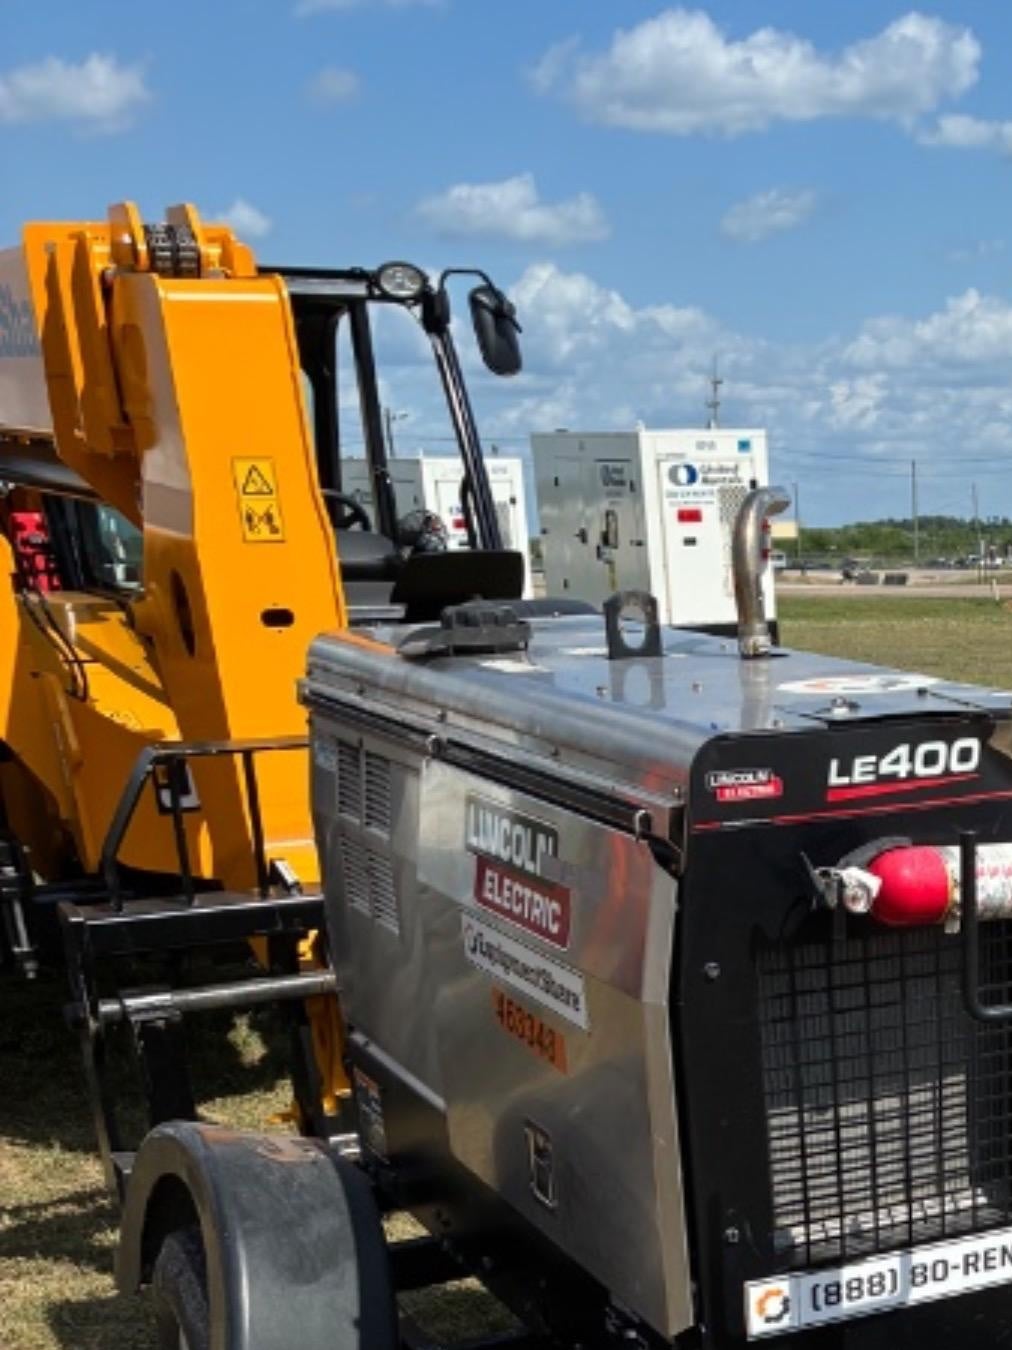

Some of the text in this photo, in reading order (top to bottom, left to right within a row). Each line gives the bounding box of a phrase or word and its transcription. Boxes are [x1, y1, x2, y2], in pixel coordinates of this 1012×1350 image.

[709, 769, 770, 788] LINCOLN
[827, 737, 981, 786] LE400
[468, 802, 555, 874] LINCOLN
[483, 867, 562, 935] ELECTRIC
[811, 1268, 898, 1311] (888)
